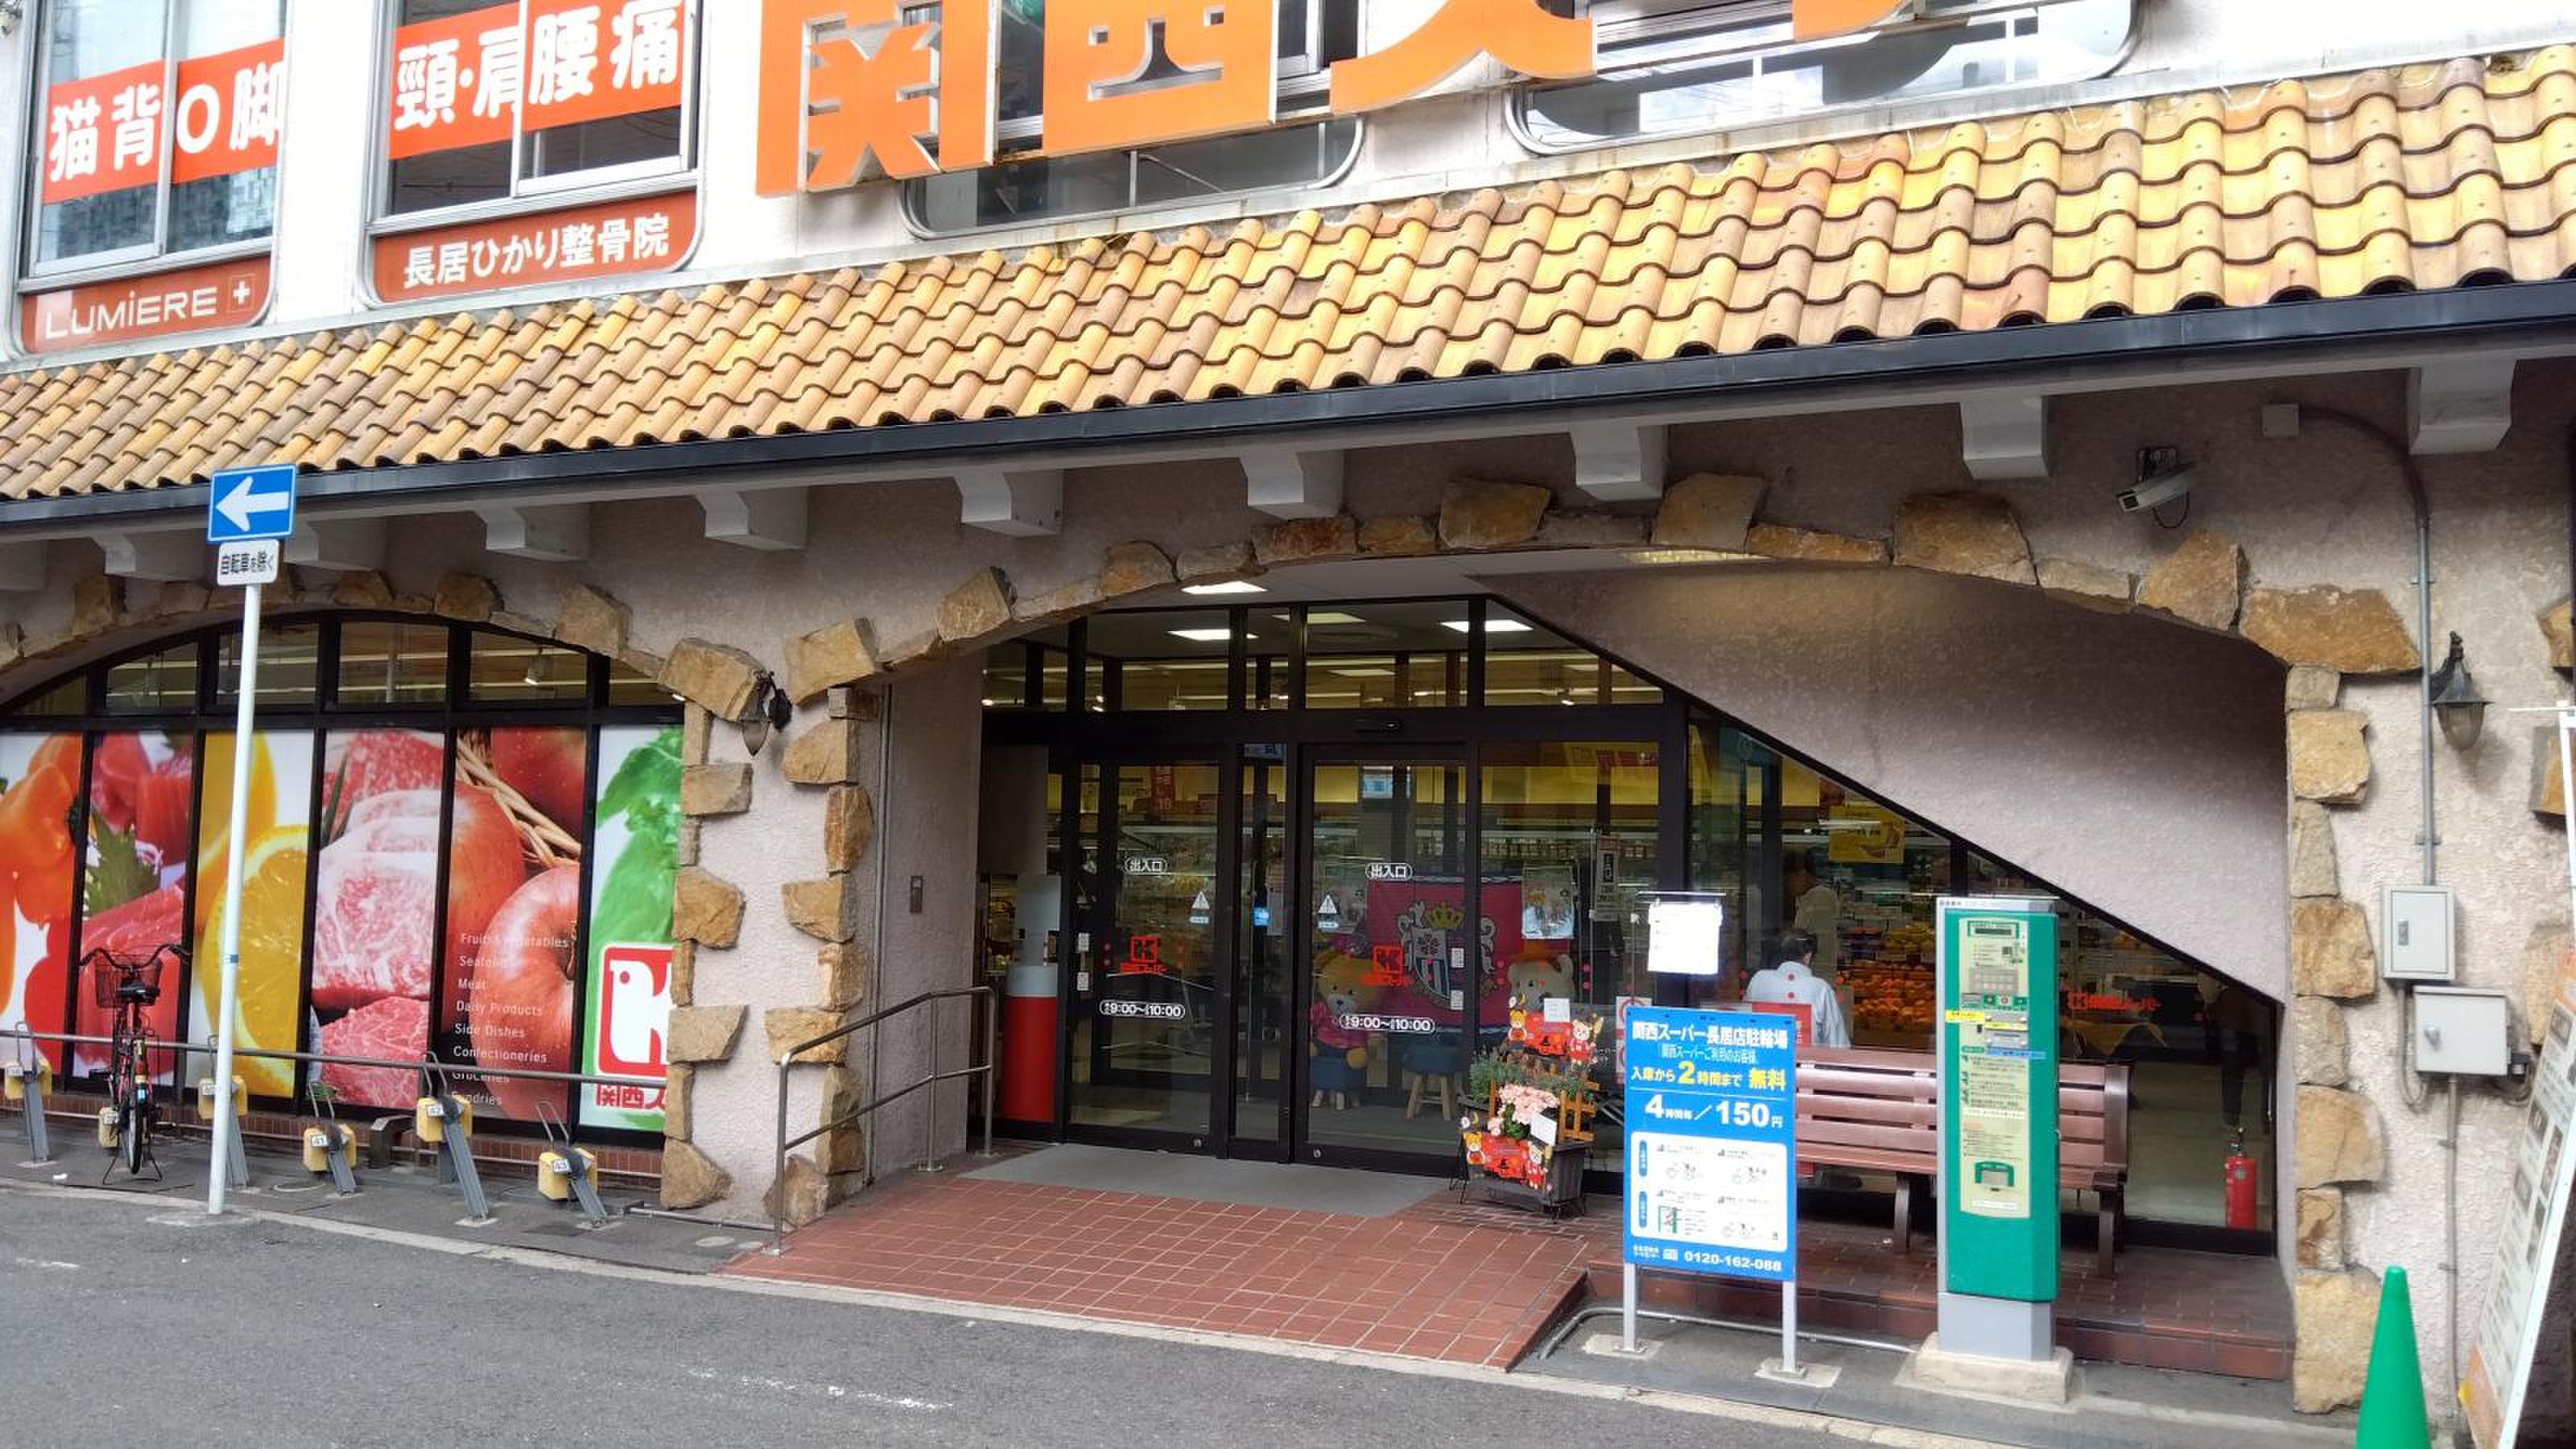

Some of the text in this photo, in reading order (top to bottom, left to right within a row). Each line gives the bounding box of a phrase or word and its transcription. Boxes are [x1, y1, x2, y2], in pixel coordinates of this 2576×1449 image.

[403, 212, 670, 288] 長居ひかり整骨院
[220, 551, 274, 575] 自転車を除く
[1129, 858, 1163, 872] 出入口
[1371, 865, 1407, 877] 出入口
[457, 978, 489, 989] Meat
[489, 1002, 543, 1016] Products
[454, 1023, 526, 1038] Side Dishes
[1632, 1022, 1788, 1050] 関西スーパー長居店駐輪場
[453, 1046, 547, 1063] Confectioneries
[451, 1091, 503, 1105] Sndries
